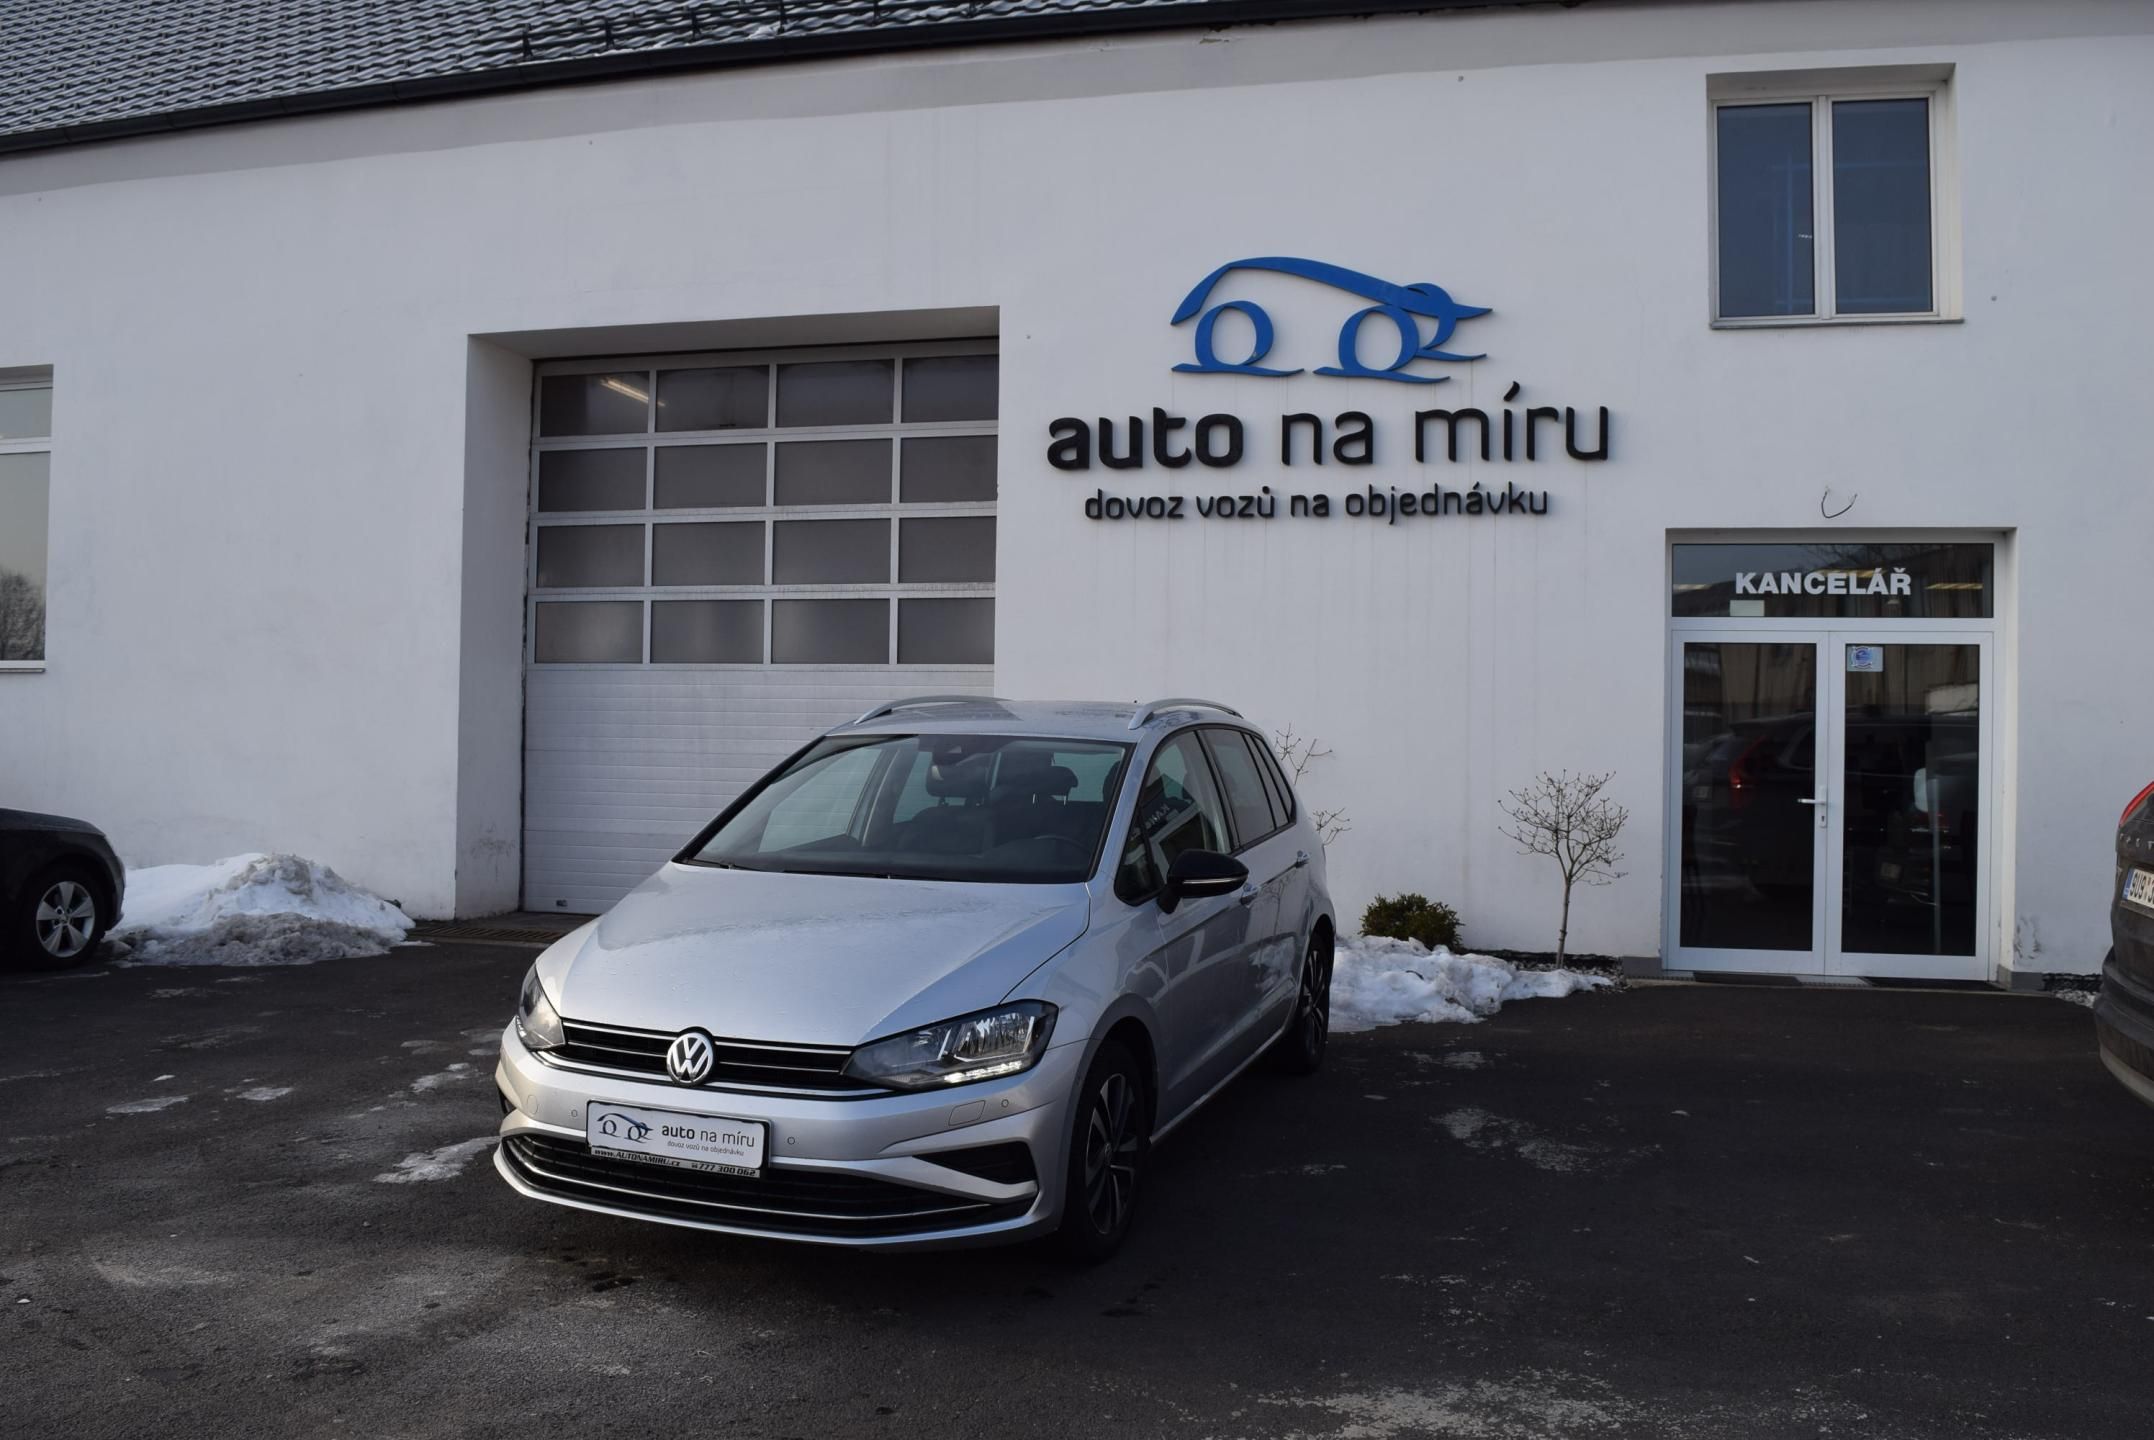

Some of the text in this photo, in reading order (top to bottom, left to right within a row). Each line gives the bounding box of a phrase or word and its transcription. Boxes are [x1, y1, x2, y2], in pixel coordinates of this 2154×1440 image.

[1046, 380, 1609, 471] auto na míru
[1084, 482, 1549, 526] dovoz vozů na objednávku
[1735, 567, 1912, 596] KANCELÁŘ
[661, 1124, 755, 1147] auto na míru
